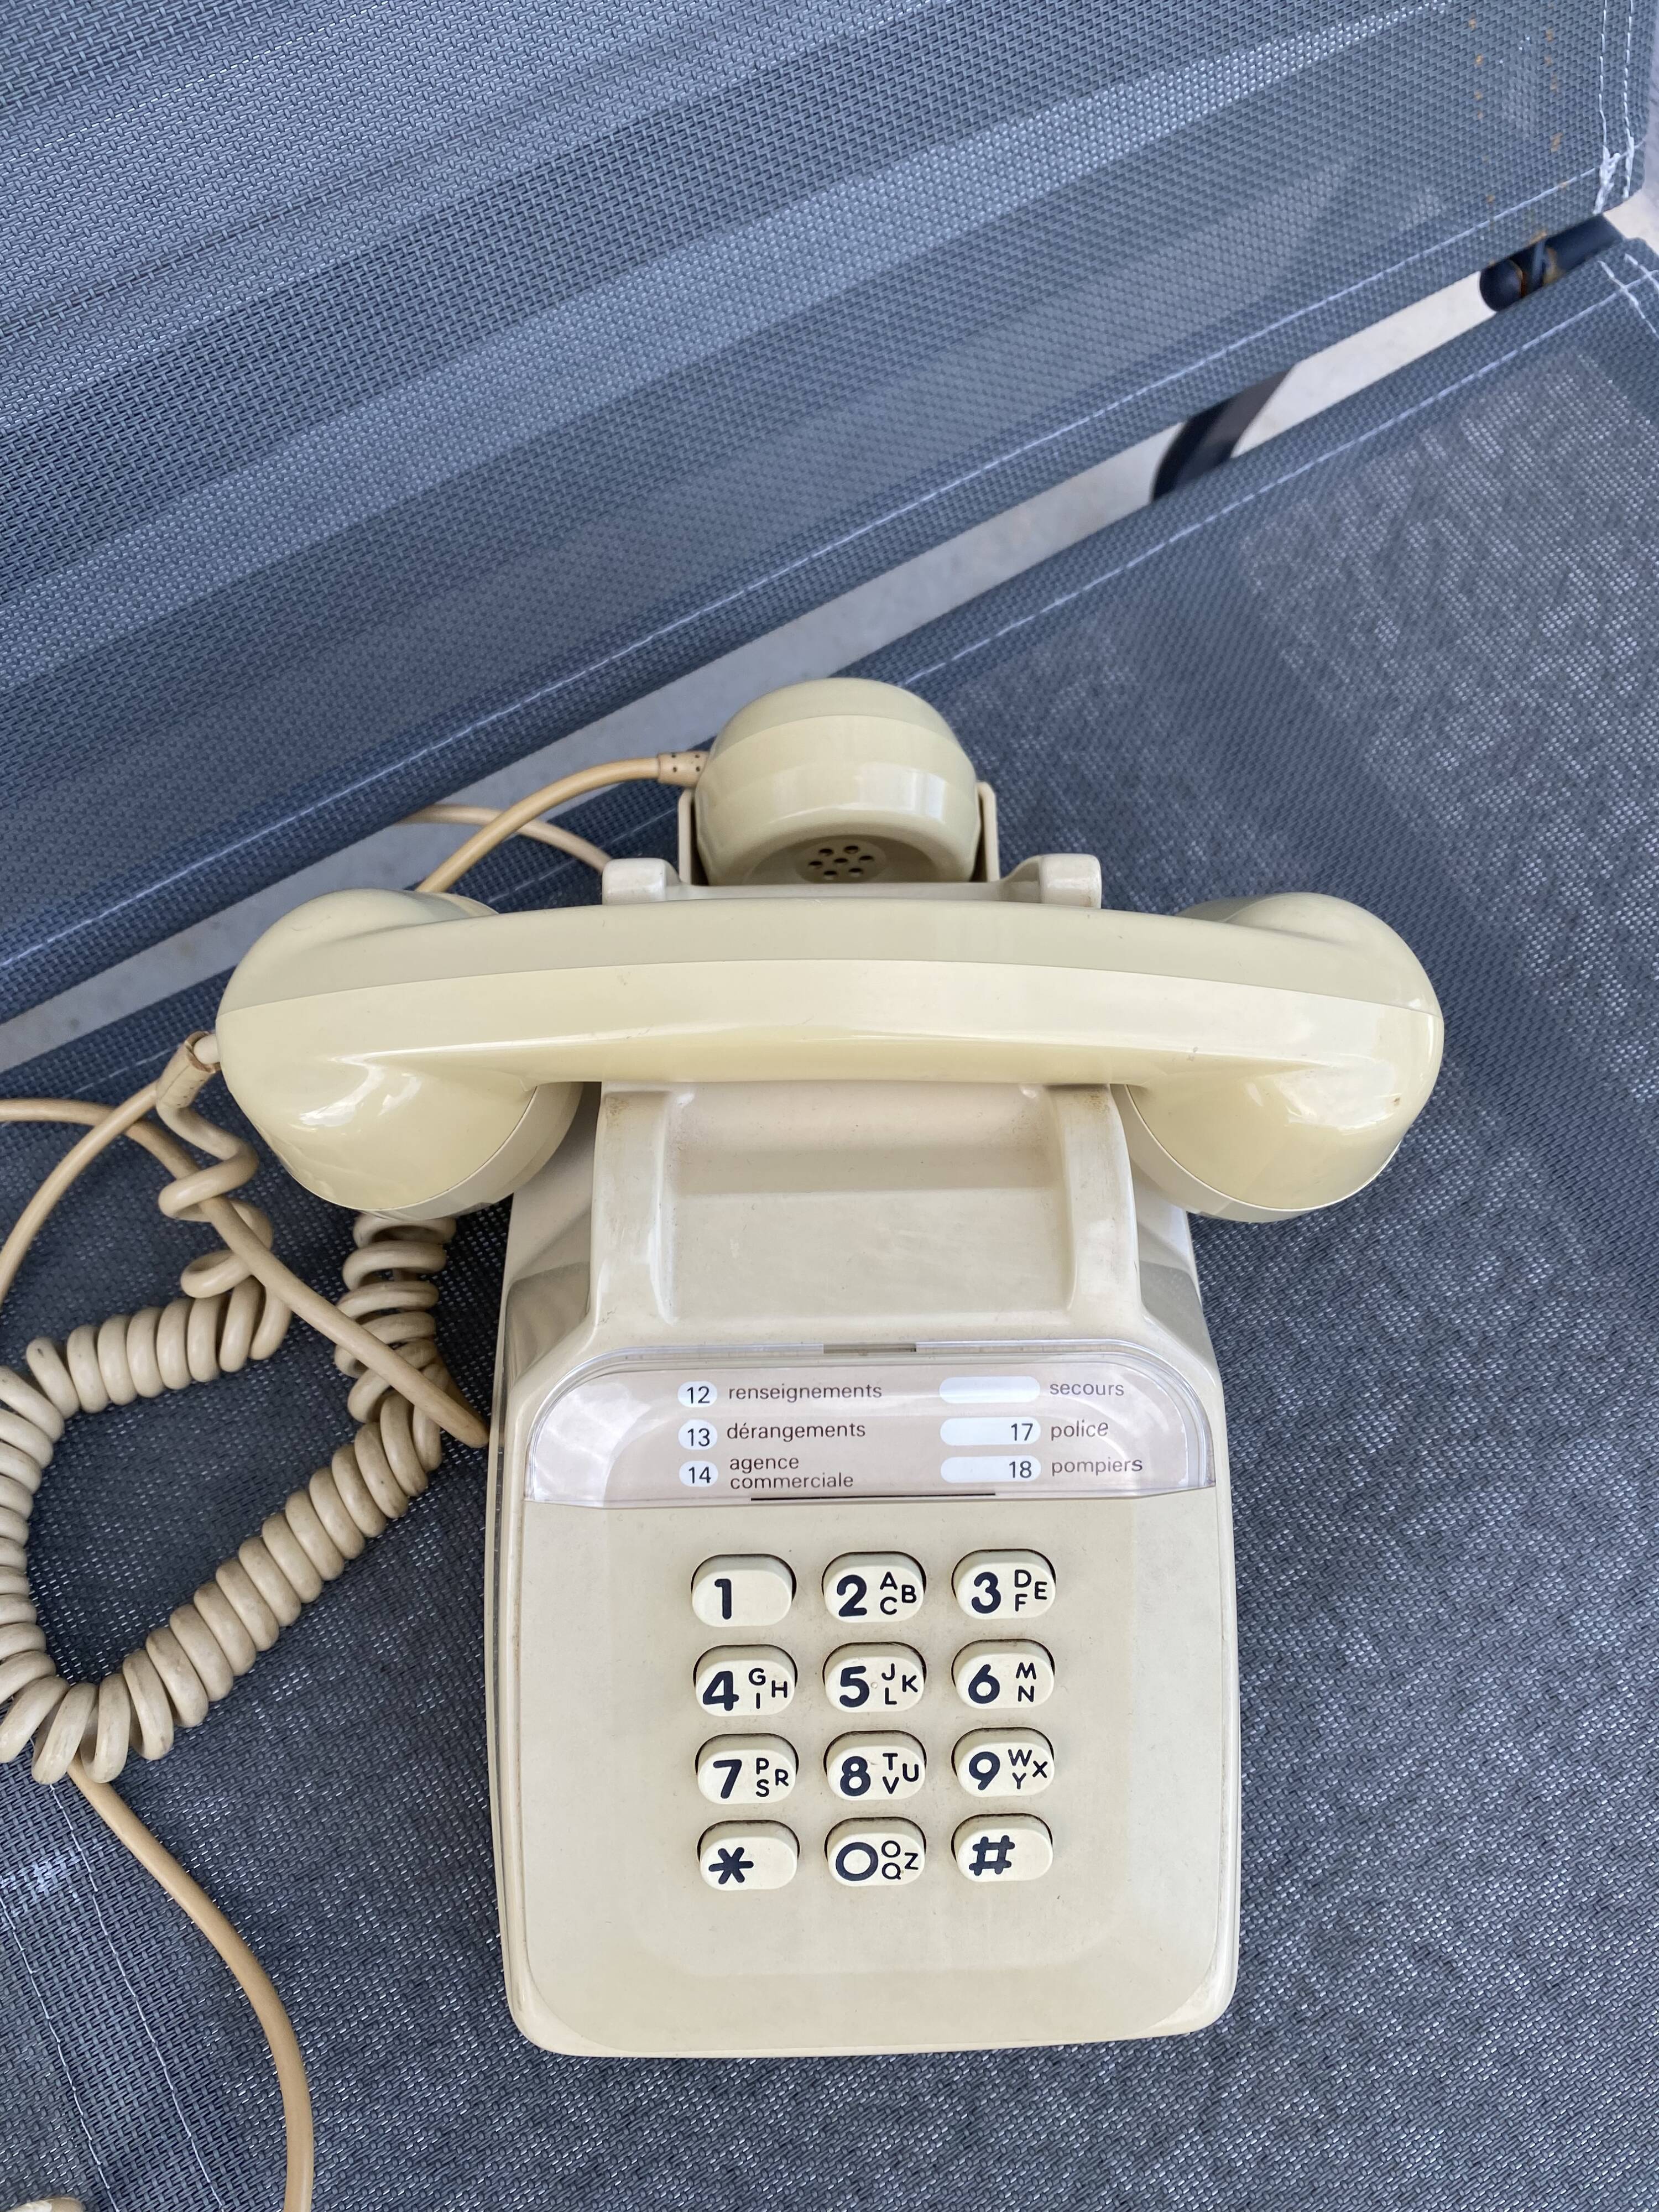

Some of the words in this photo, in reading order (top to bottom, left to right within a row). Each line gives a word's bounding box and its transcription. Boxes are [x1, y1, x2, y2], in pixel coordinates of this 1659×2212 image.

[686, 1386, 711, 1404] 12
[728, 1384, 882, 1403] renseignements
[1050, 1383, 1124, 1396] secours
[687, 1428, 711, 1447] 13
[726, 1422, 866, 1442] dérangements
[1010, 1423, 1034, 1441] 17
[1050, 1419, 1109, 1441] police
[688, 1467, 712, 1484] 14
[729, 1457, 799, 1474] agence
[729, 1472, 854, 1490] commerciale
[1009, 1460, 1032, 1479] 18
[1051, 1457, 1143, 1477] pompiers
[714, 1578, 732, 1620] 1
[836, 1574, 868, 1617] 2
[971, 1572, 1001, 1614] 3
[702, 1671, 739, 1712] 4
[839, 1666, 870, 1708] 5
[968, 1664, 1000, 1704] 6
[713, 1759, 742, 1799] 7
[840, 1756, 871, 1797] 8
[968, 1751, 1000, 1791] 9
